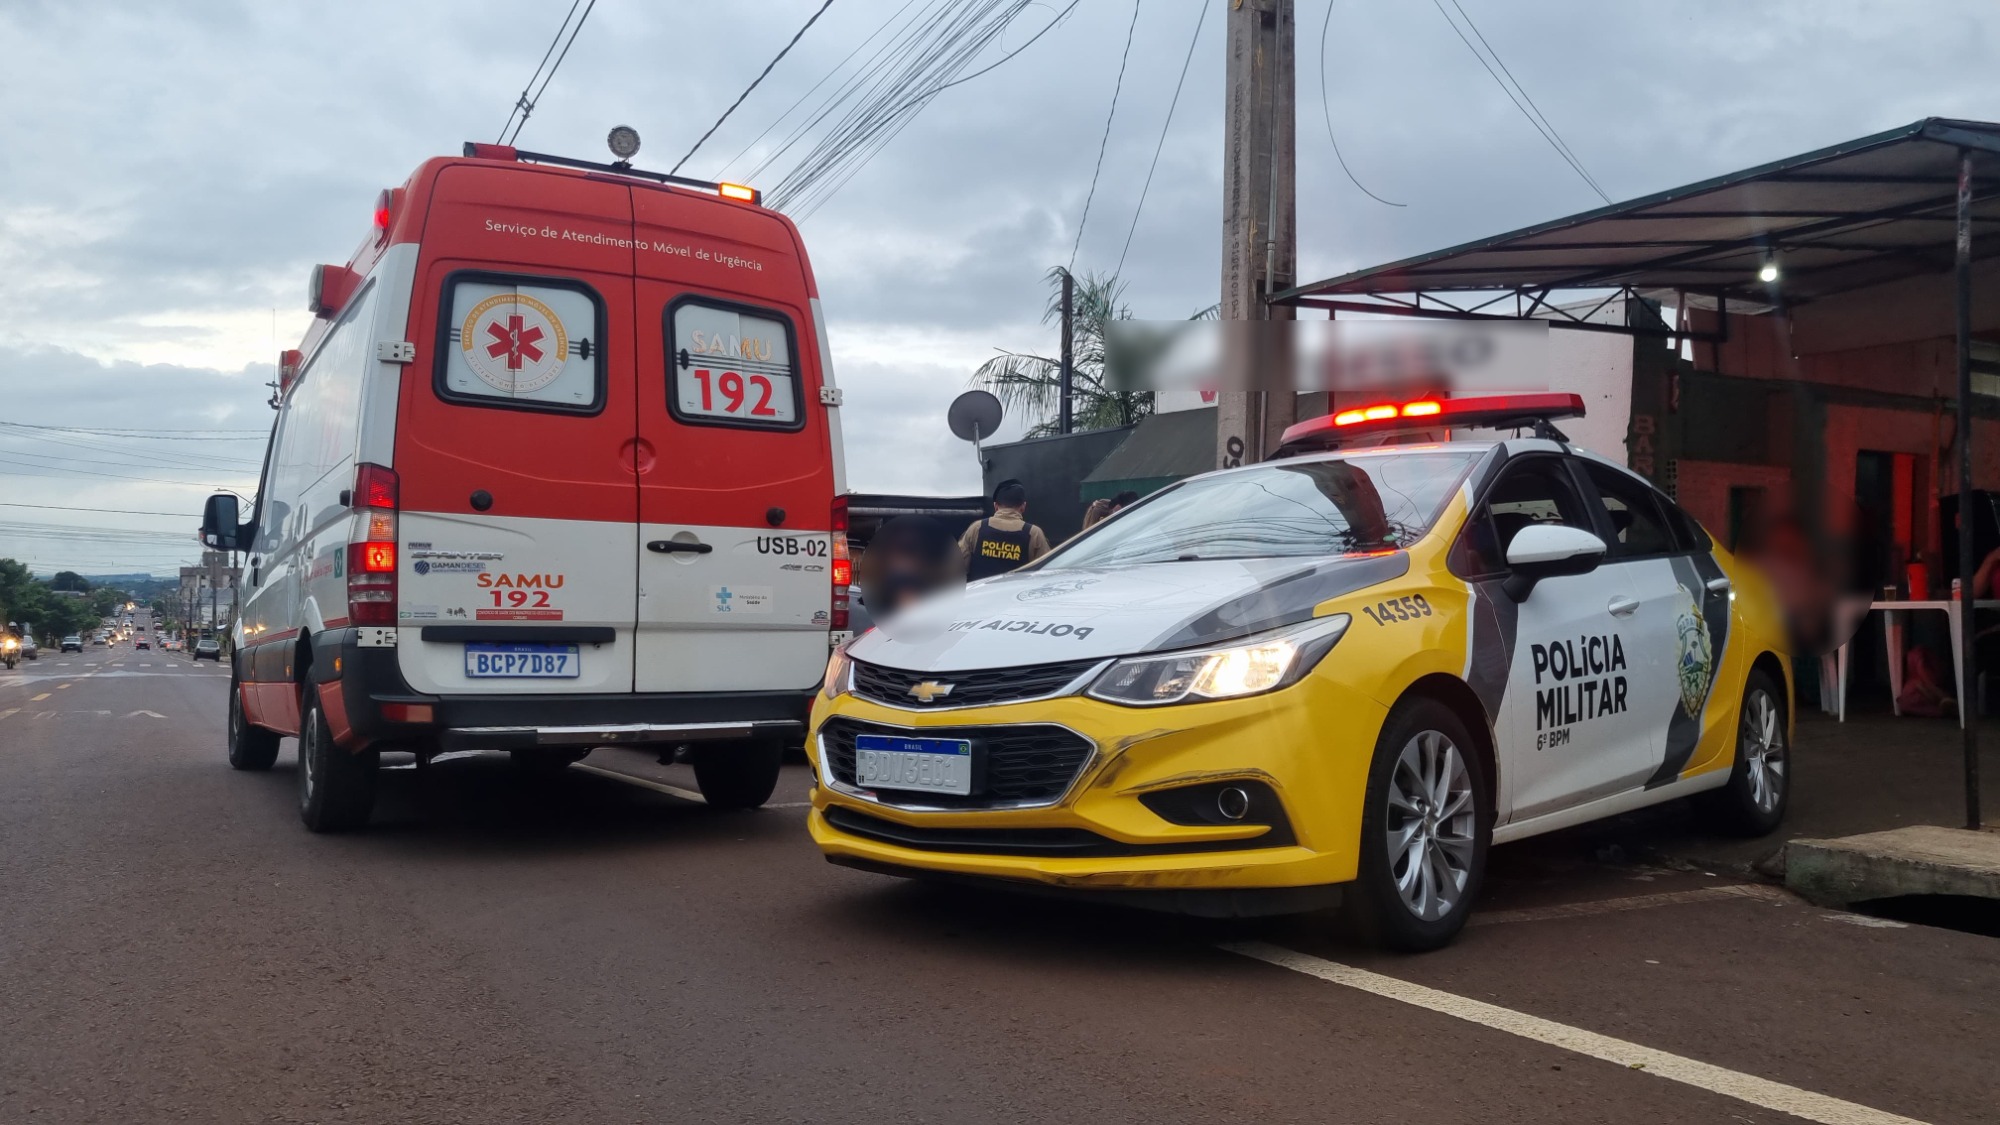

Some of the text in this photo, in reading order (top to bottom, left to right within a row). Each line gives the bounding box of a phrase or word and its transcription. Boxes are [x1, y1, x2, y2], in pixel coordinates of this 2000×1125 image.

[485, 219, 762, 271] Serviço de Atendimento Móvel de Urgência
[691, 329, 772, 361] SAMU
[693, 369, 776, 417] 192
[756, 536, 827, 557] USB-02
[981, 548, 1021, 561] MILITAR
[982, 540, 1021, 553] POLÍCIA
[476, 573, 564, 589] SAMU
[489, 590, 551, 608] 192
[1362, 593, 1432, 627] 14359
[476, 654, 568, 674] BCP7D87
[1531, 633, 1627, 684] POLÍCIA
[1536, 676, 1628, 731] MILITAR
[903, 743, 923, 751] BRASIL
[1549, 728, 1570, 749] BPM
